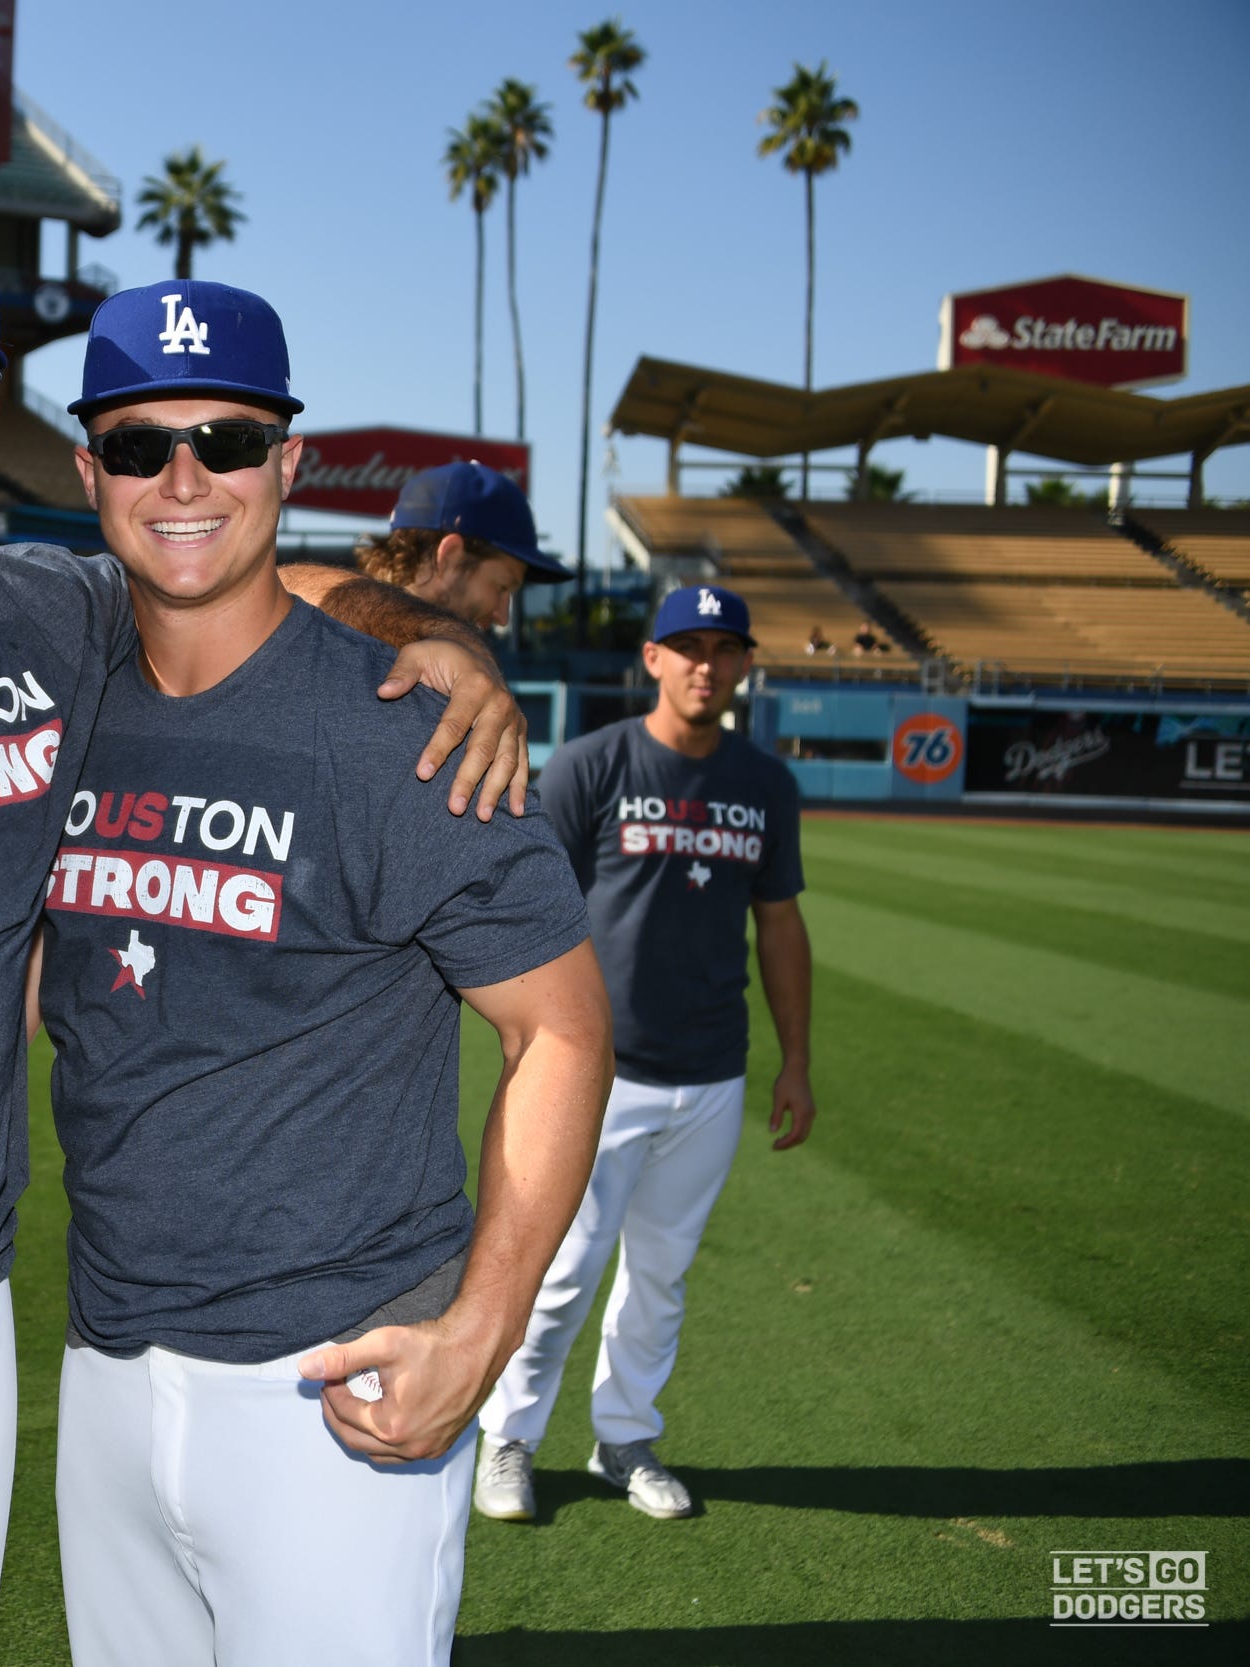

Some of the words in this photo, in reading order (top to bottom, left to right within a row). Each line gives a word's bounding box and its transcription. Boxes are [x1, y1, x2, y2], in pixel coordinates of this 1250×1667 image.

[159, 293, 211, 355] LA
[697, 588, 723, 616] LA
[903, 726, 955, 771] 76
[1003, 727, 1111, 782] Dodgers
[1185, 739, 1250, 780] LE
[65, 789, 295, 861] OUSTON
[618, 796, 766, 832] HOUSTON
[622, 824, 763, 862] STRONG
